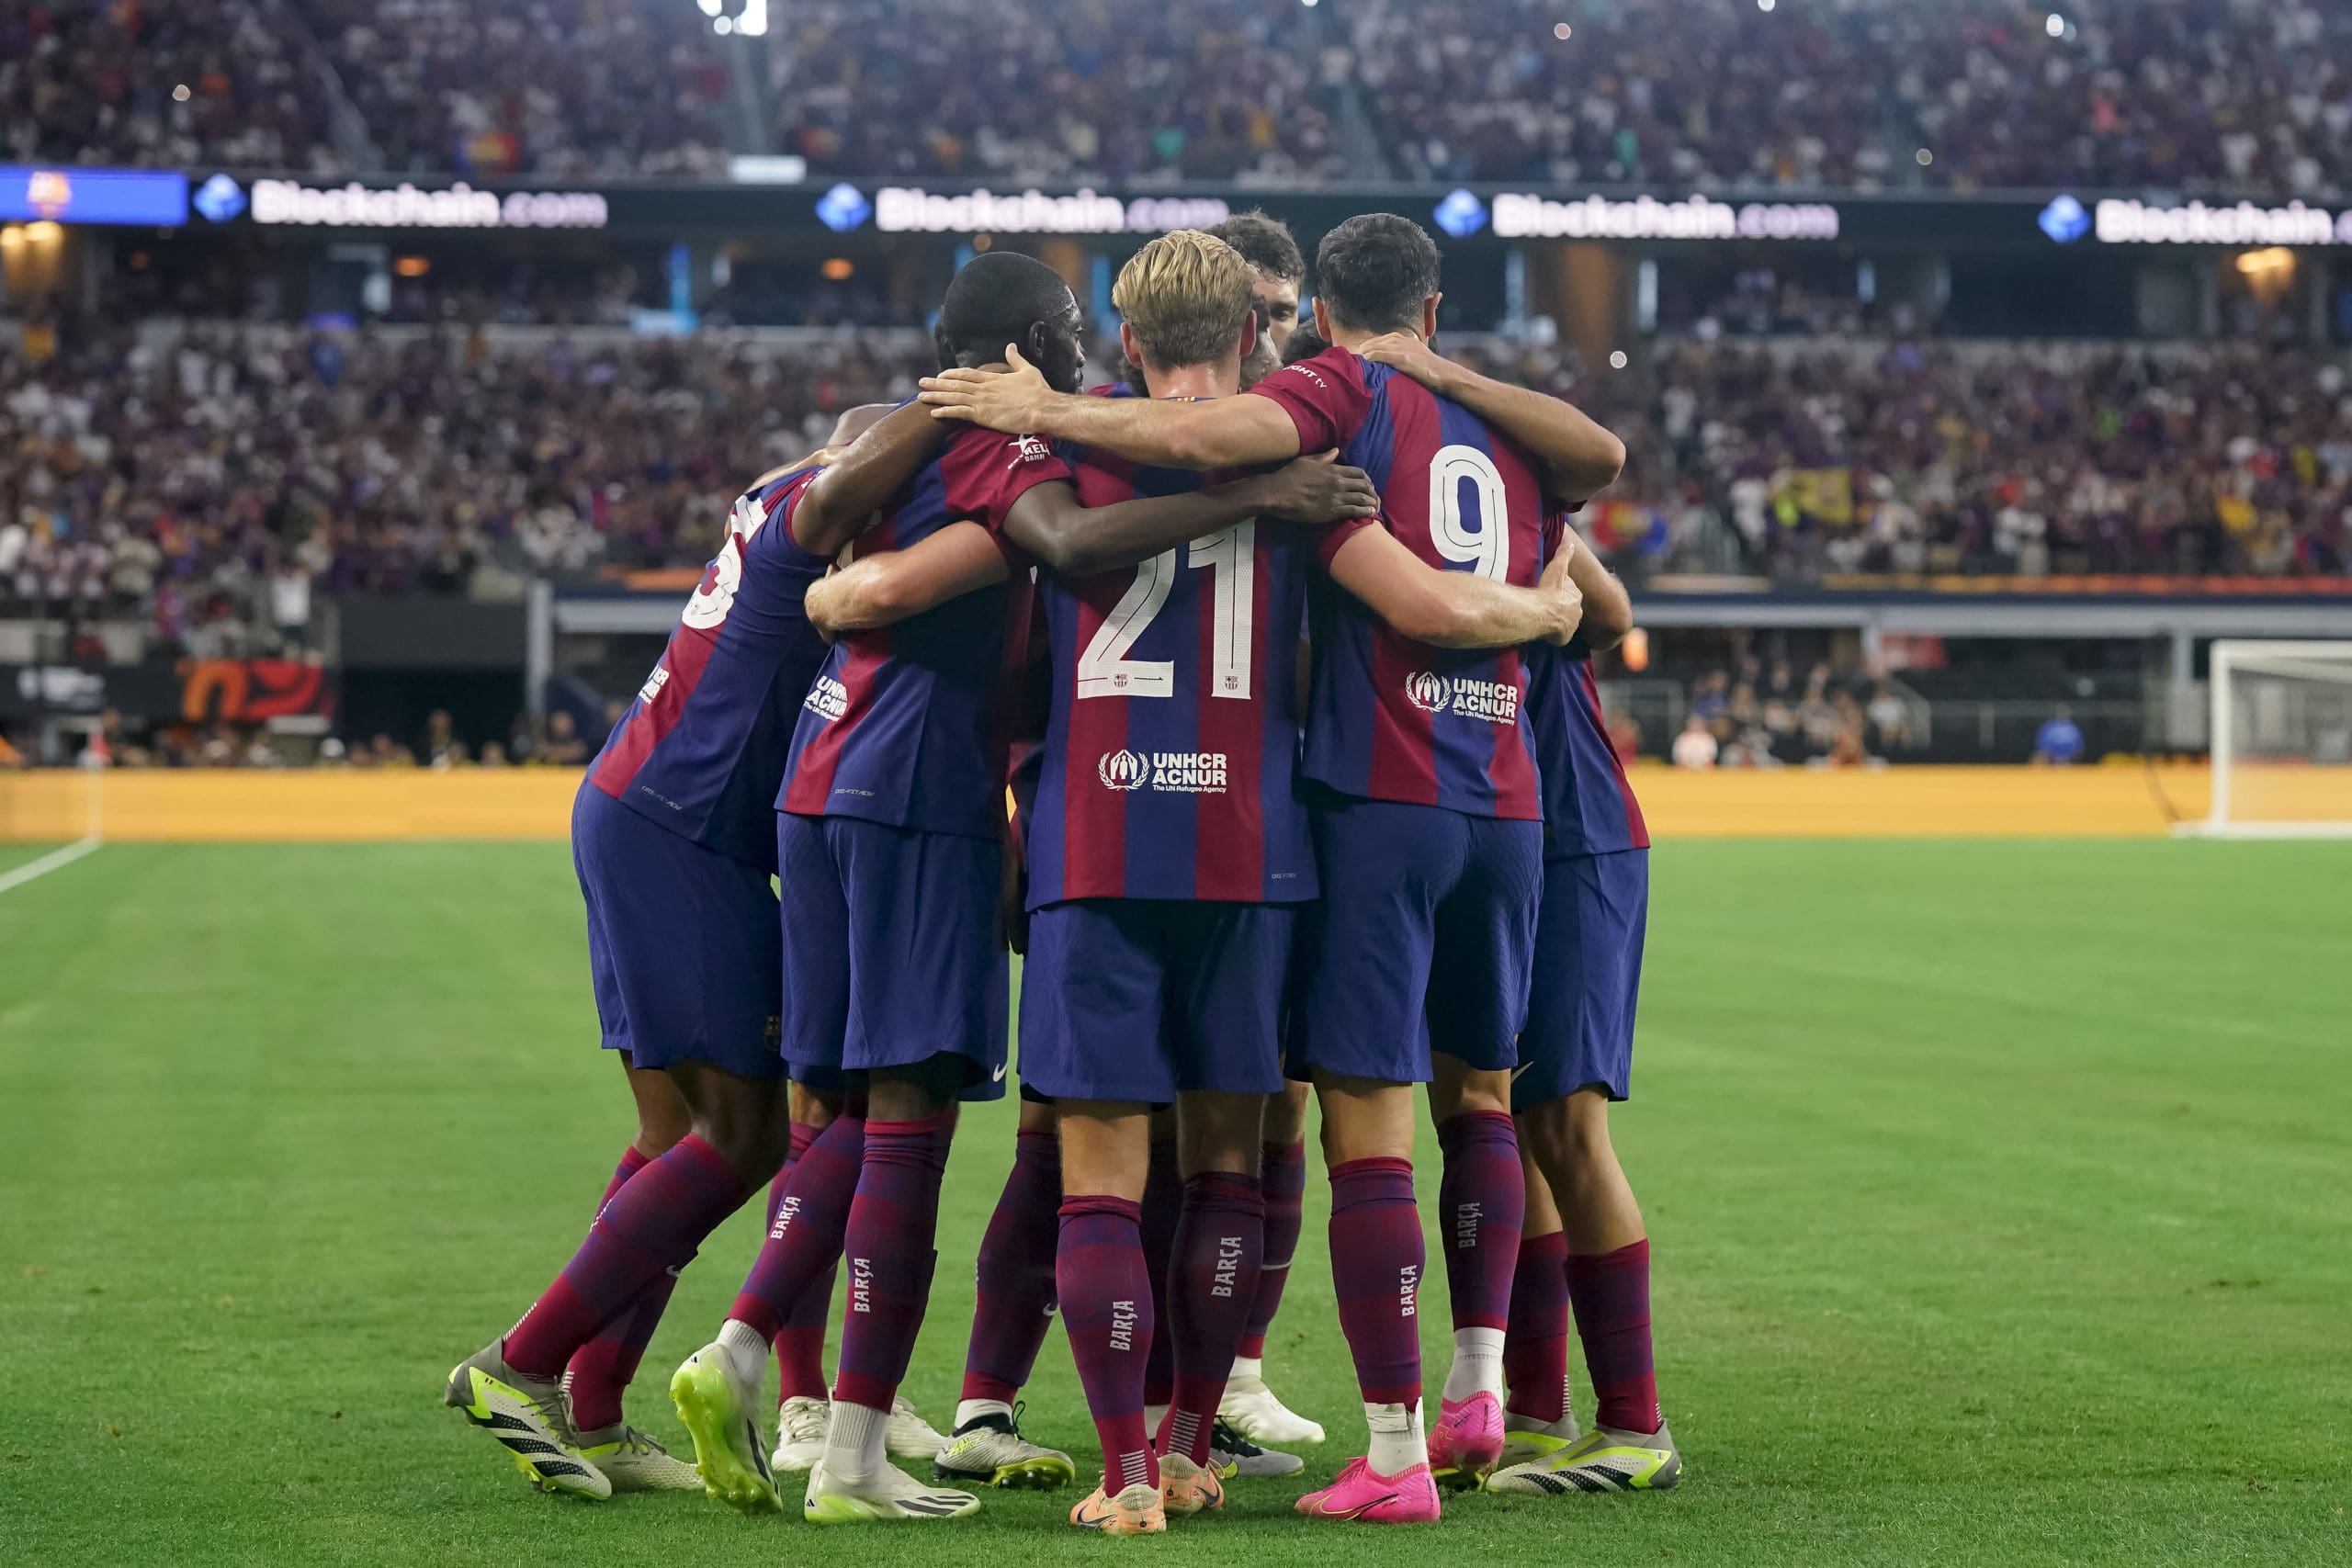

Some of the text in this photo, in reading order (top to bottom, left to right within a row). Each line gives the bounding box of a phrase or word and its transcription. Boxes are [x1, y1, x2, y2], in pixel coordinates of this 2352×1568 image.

[1430, 445, 1510, 585] 9
[1078, 516, 1256, 699] 21
[1453, 678, 1518, 703] UNHCR
[1453, 694, 1517, 718] ACNUR
[1151, 768, 1227, 786] ACNUR
[1153, 752, 1227, 770] UNHCR
[1152, 784, 1165, 792] The
[1176, 785, 1203, 794] Refugee
[1203, 785, 1227, 795] Agency
[771, 1196, 801, 1240] BARÇA
[1457, 1202, 1484, 1248] BARÇA
[854, 1258, 874, 1313] BARÇA
[1211, 1236, 1243, 1297] BARÇA
[1400, 1264, 1418, 1317] BARÇA
[1109, 1301, 1138, 1351] BARÇA
